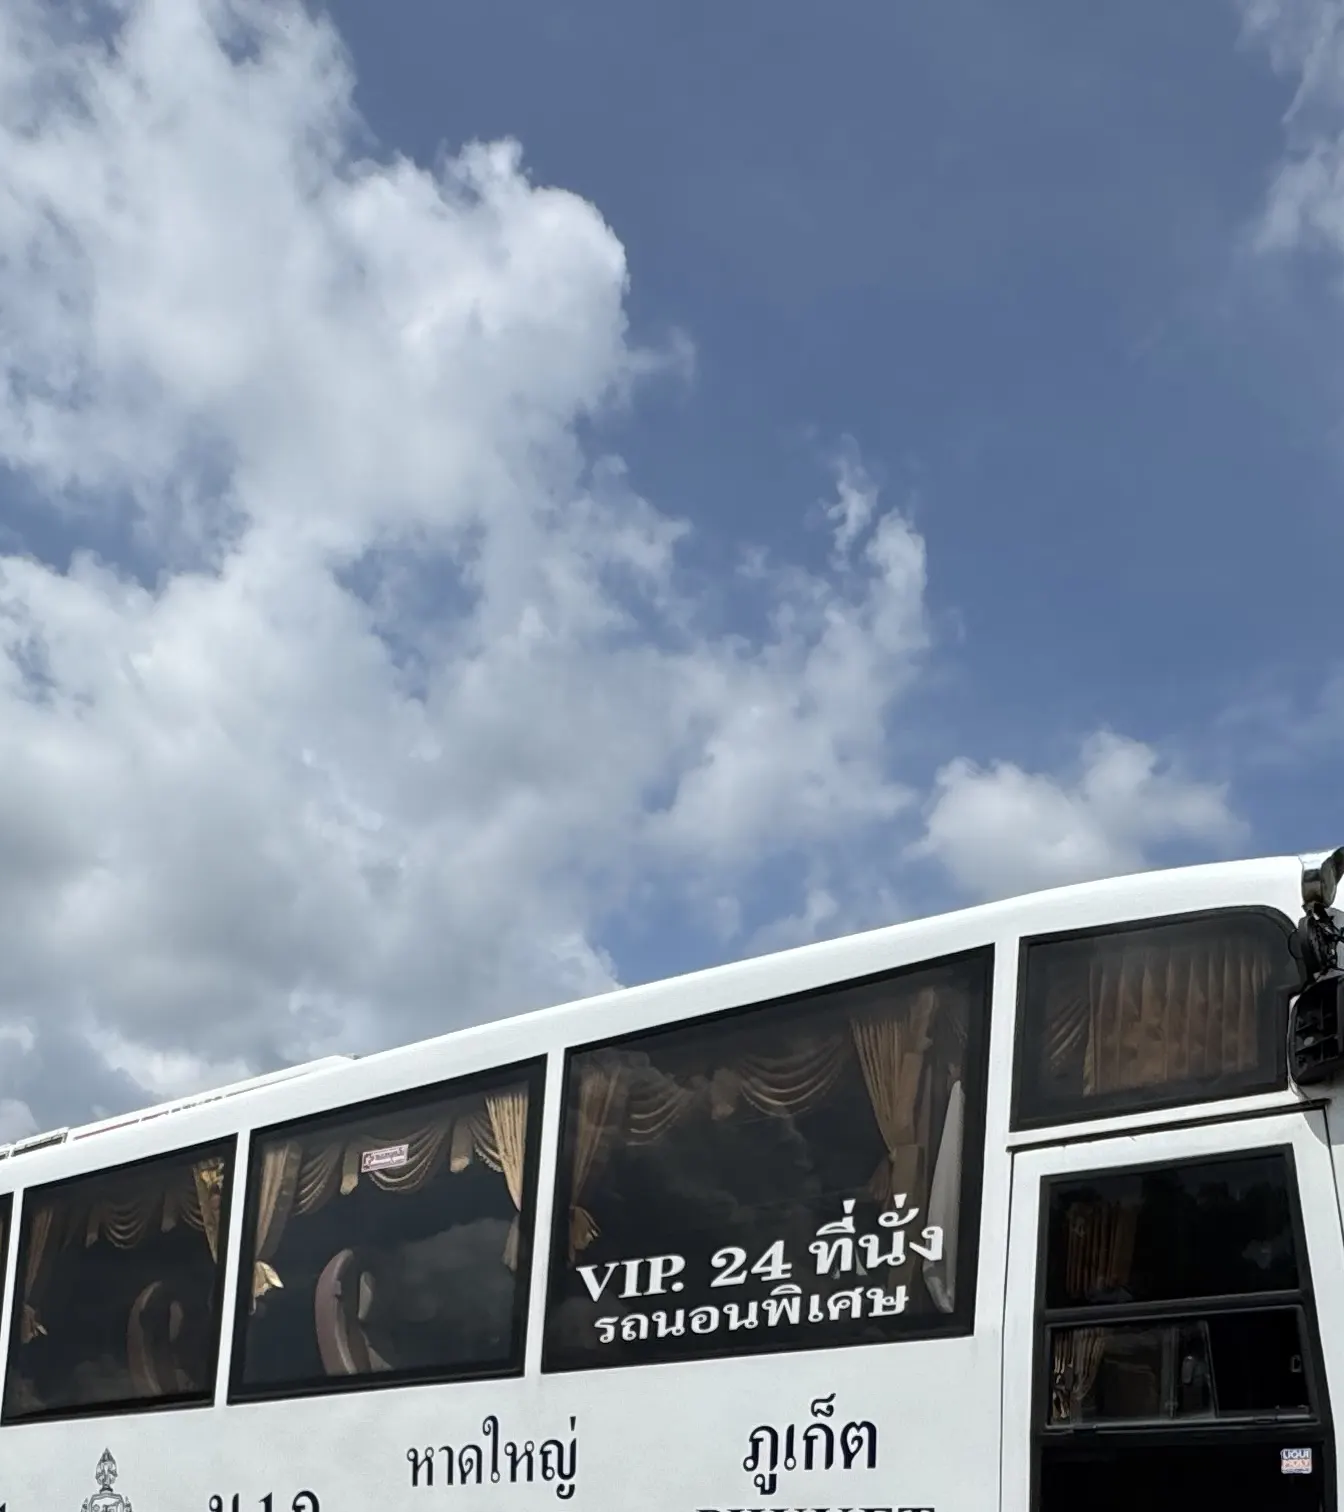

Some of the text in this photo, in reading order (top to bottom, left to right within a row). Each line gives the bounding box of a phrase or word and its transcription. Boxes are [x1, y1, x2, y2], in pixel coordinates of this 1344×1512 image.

[710, 1240, 792, 1288] 24
[808, 1193, 944, 1279] ที่นั่ง
[594, 1284, 909, 1344] รถนอนพิเศษ
[406, 1415, 577, 1500] หาดใหญ่
[743, 1393, 878, 1496] ภูเก็ต
